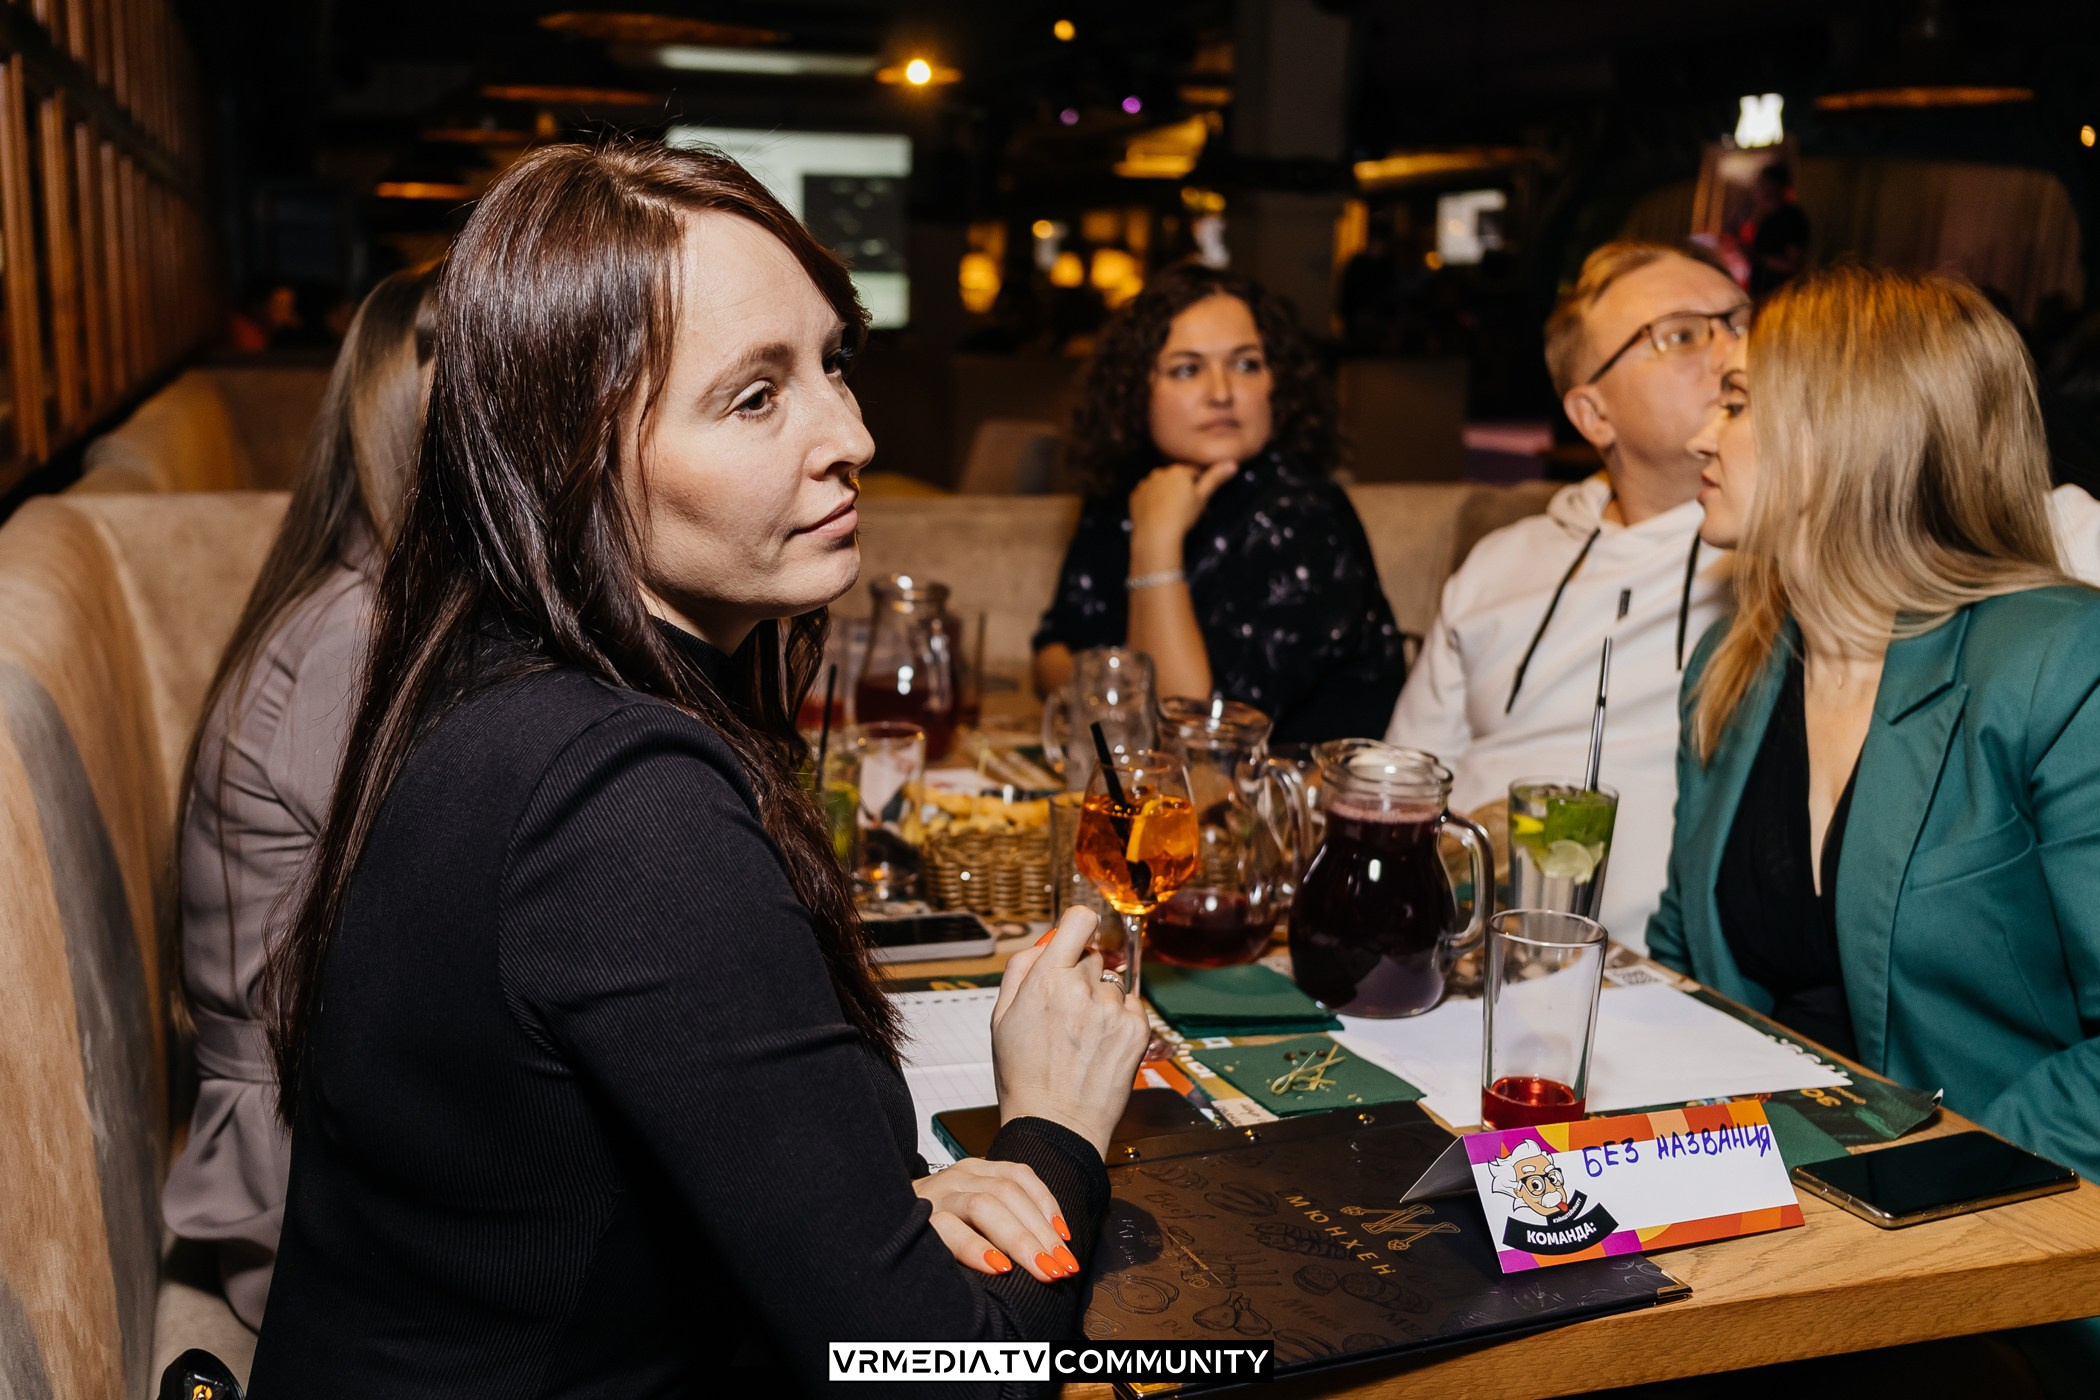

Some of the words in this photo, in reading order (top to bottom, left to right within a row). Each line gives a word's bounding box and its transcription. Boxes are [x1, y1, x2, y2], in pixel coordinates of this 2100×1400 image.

[1582, 1137, 1639, 1177] БЕЗ
[1285, 1195, 1396, 1275] МЮНХЕН
[1526, 1222, 1597, 1246] КОМАНДА:
